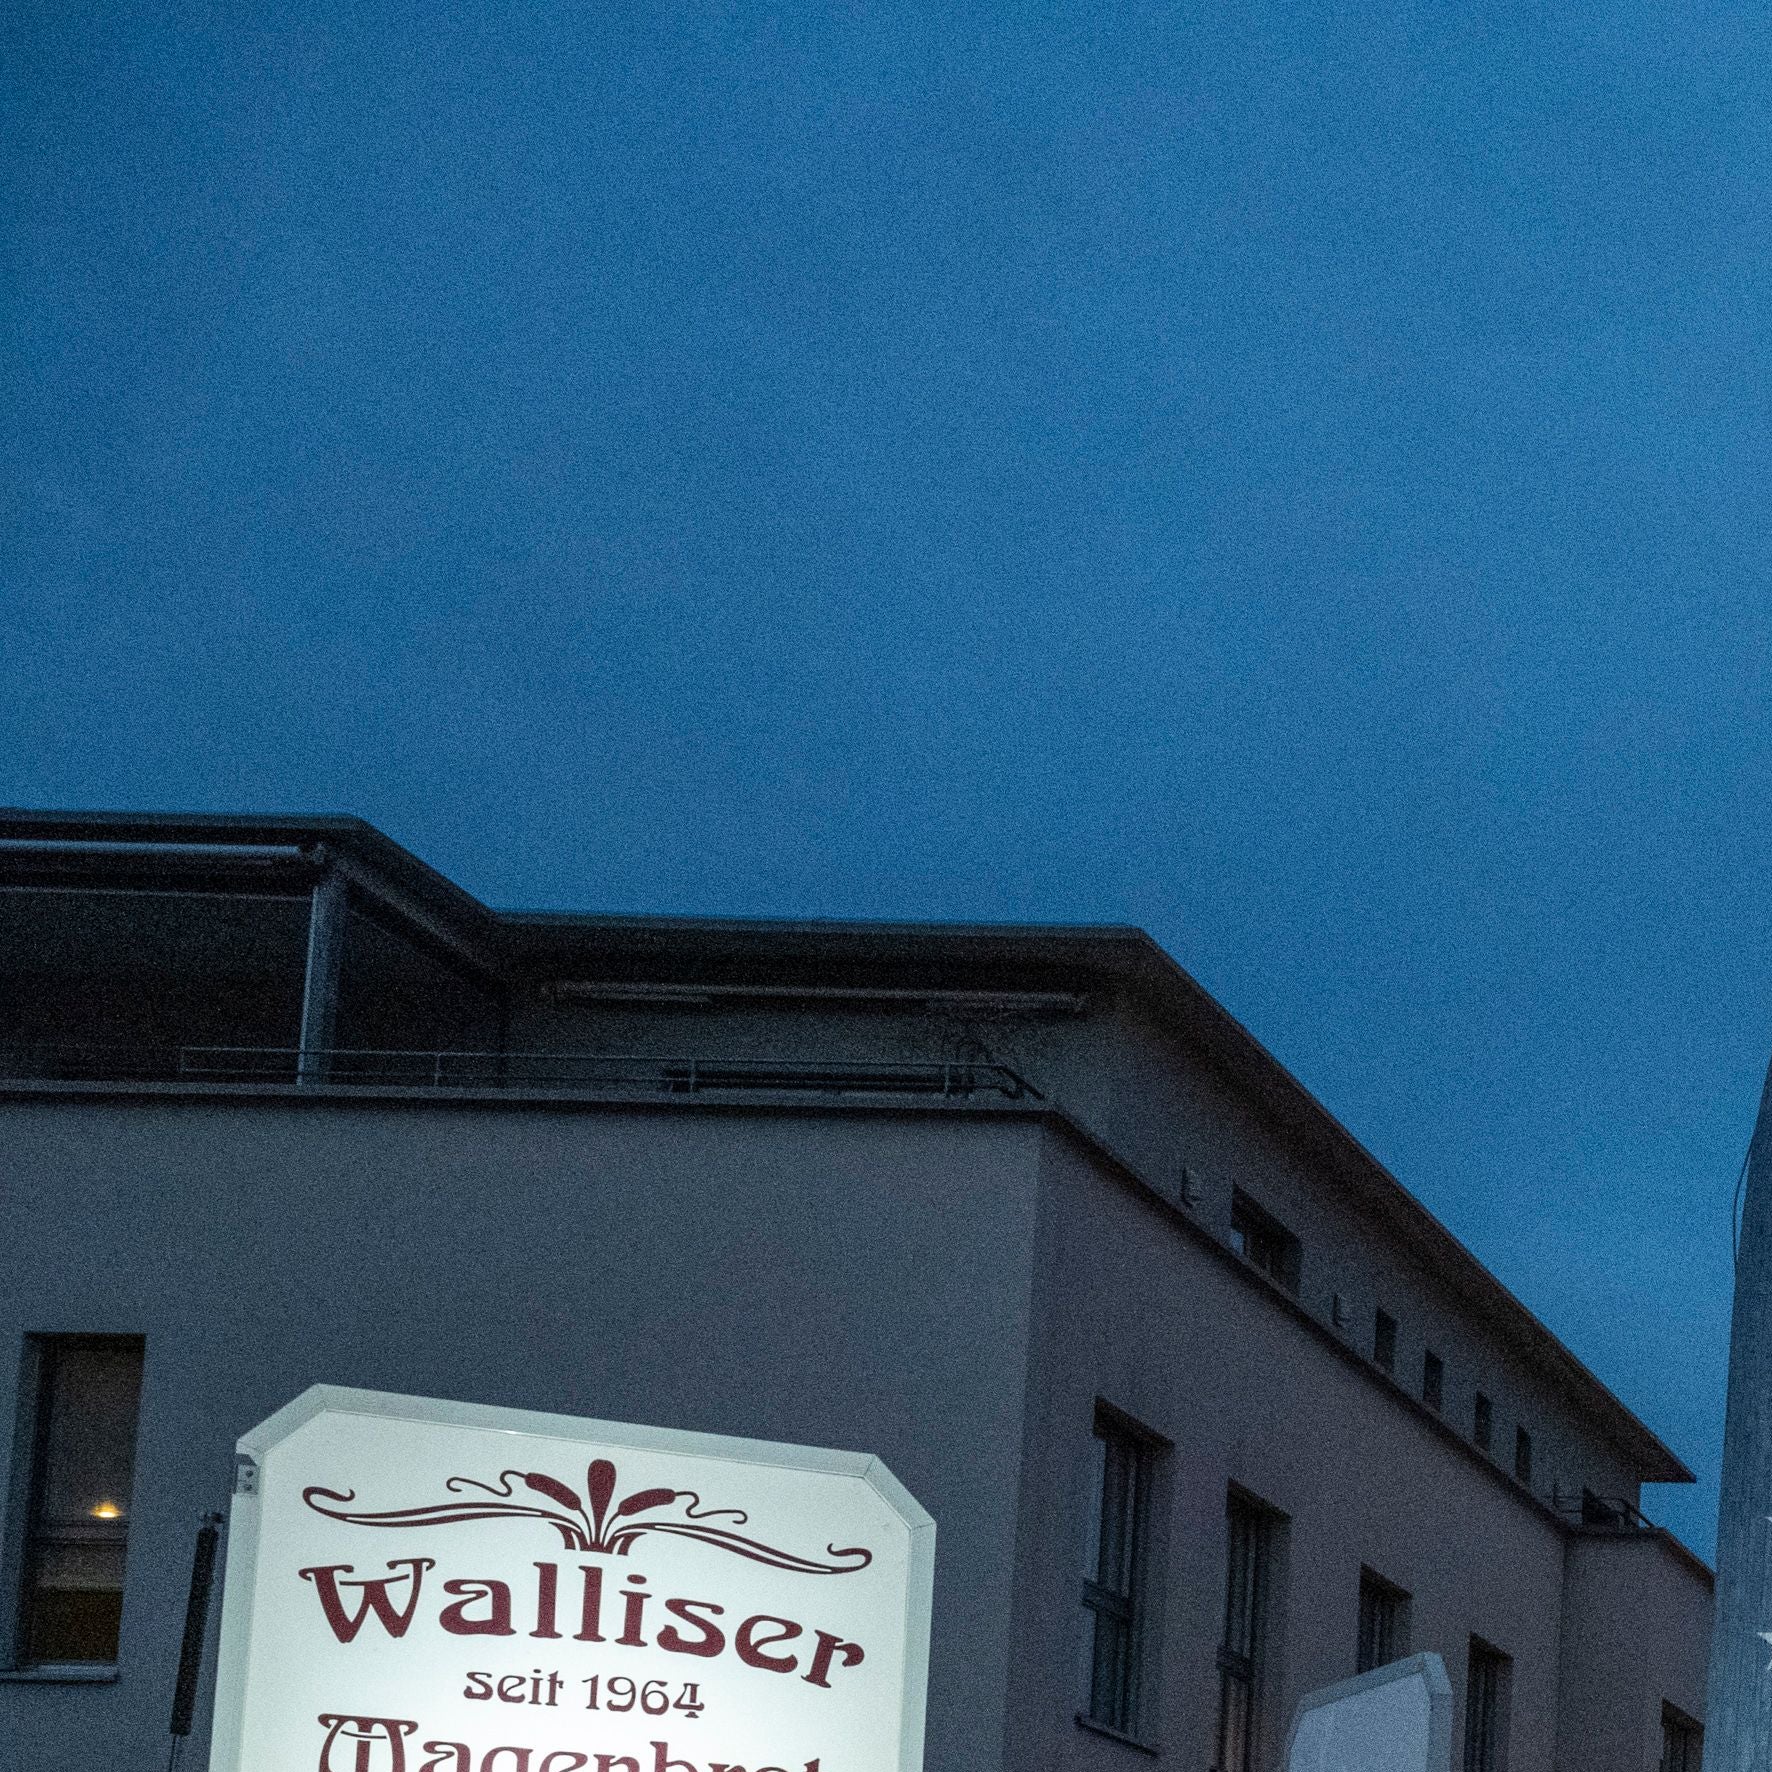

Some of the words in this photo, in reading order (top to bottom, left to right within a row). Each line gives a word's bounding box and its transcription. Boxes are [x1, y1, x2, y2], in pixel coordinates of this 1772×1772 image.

[299, 1556, 866, 1690] Walliser
[462, 1667, 564, 1709] seit
[583, 1673, 705, 1719] 1964
